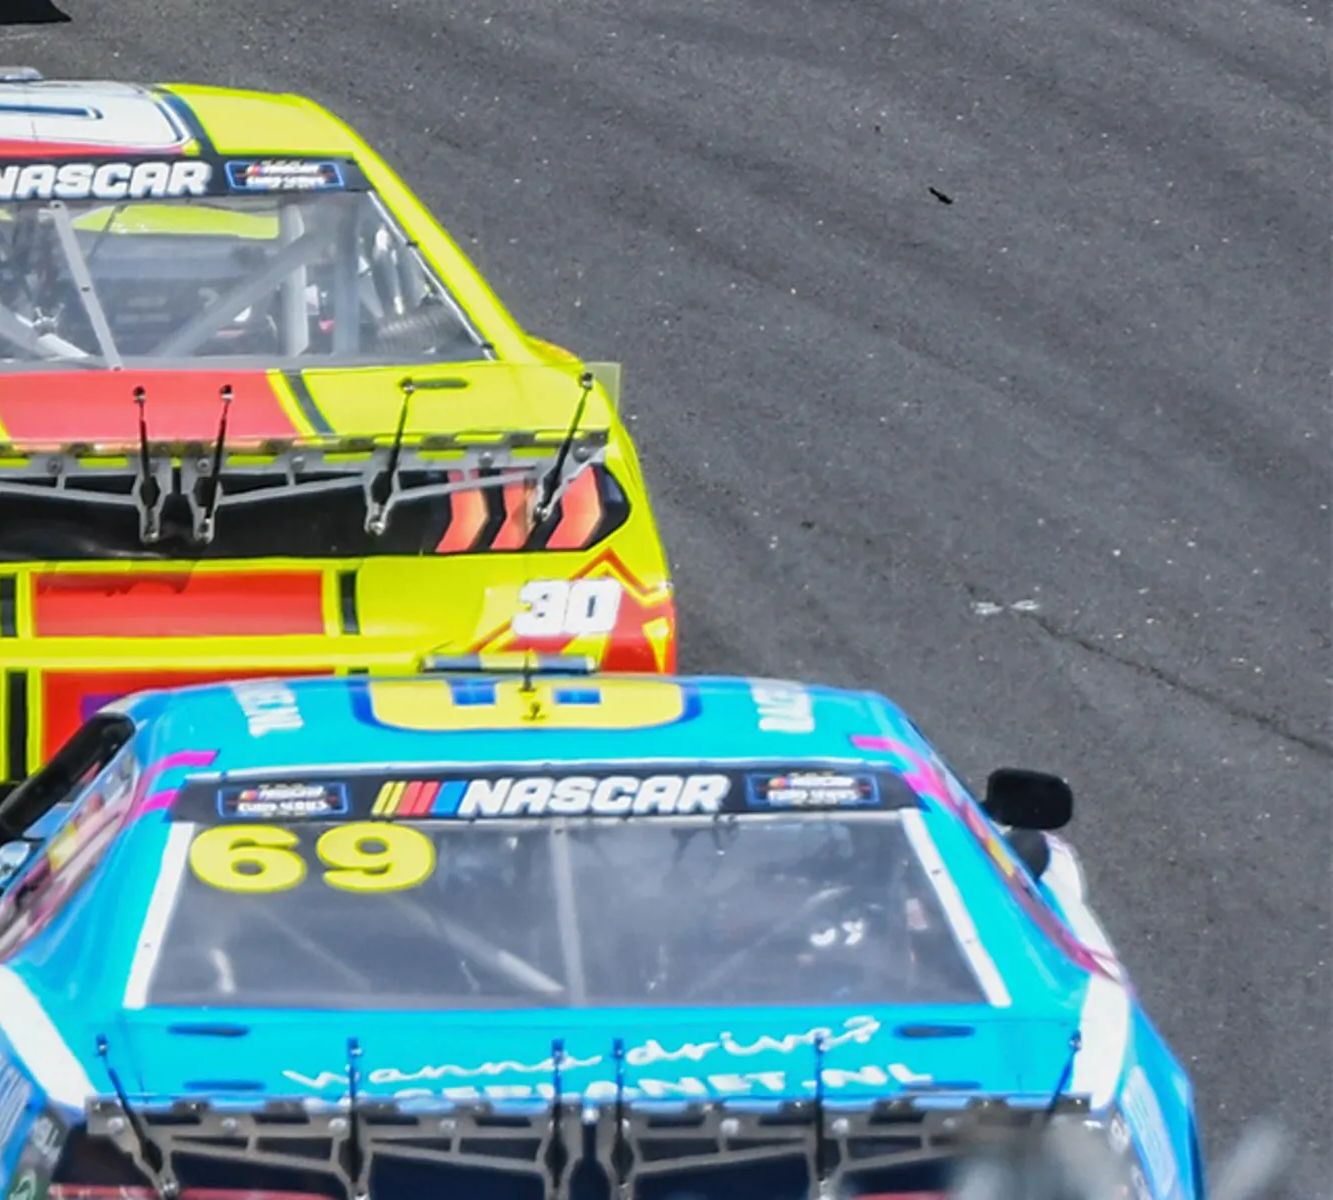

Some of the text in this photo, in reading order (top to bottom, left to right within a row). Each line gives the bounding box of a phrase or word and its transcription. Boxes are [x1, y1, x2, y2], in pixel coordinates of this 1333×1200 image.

[512, 577, 623, 637] 30
[459, 774, 731, 816] NASCAR
[190, 821, 436, 894] 69
